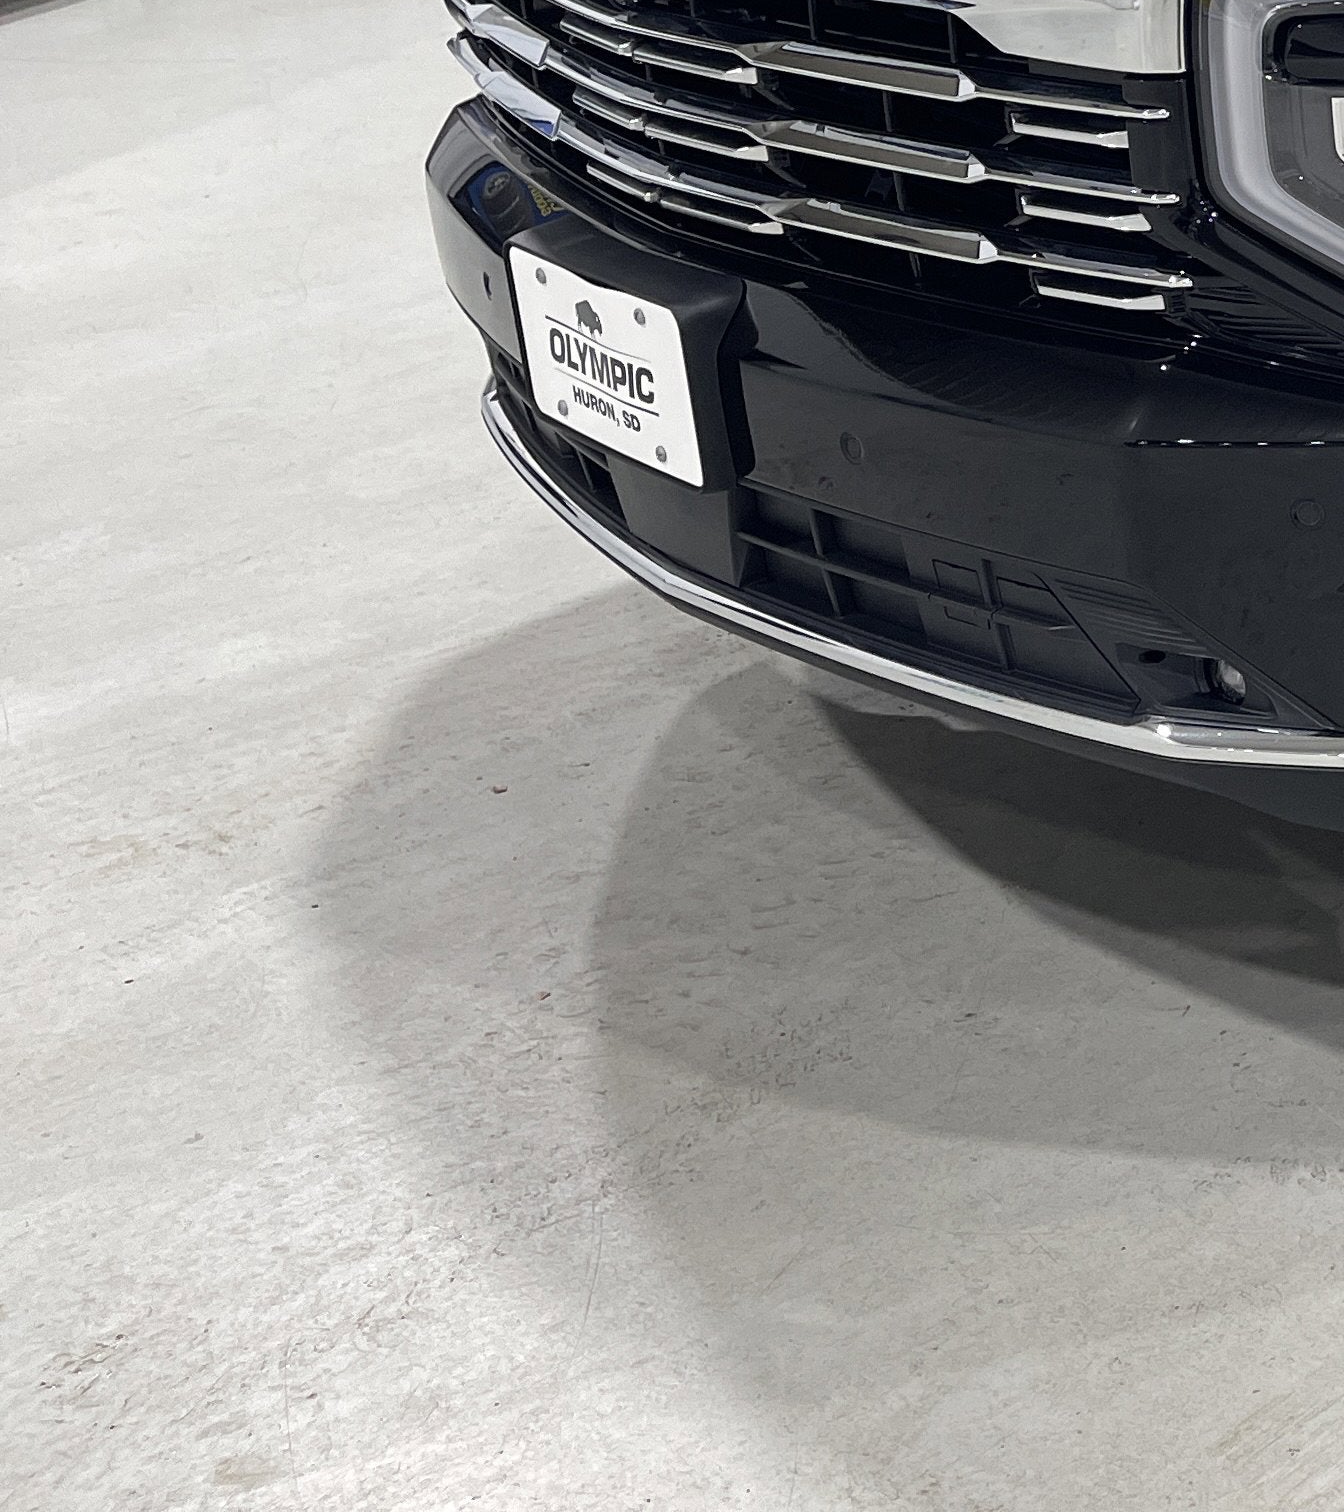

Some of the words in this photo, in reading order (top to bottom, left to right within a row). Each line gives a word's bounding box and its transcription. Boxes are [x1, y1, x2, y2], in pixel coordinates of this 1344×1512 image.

[549, 327, 655, 405] OLYMPIC
[572, 384, 621, 427] HURON,
[622, 410, 642, 433] SD
